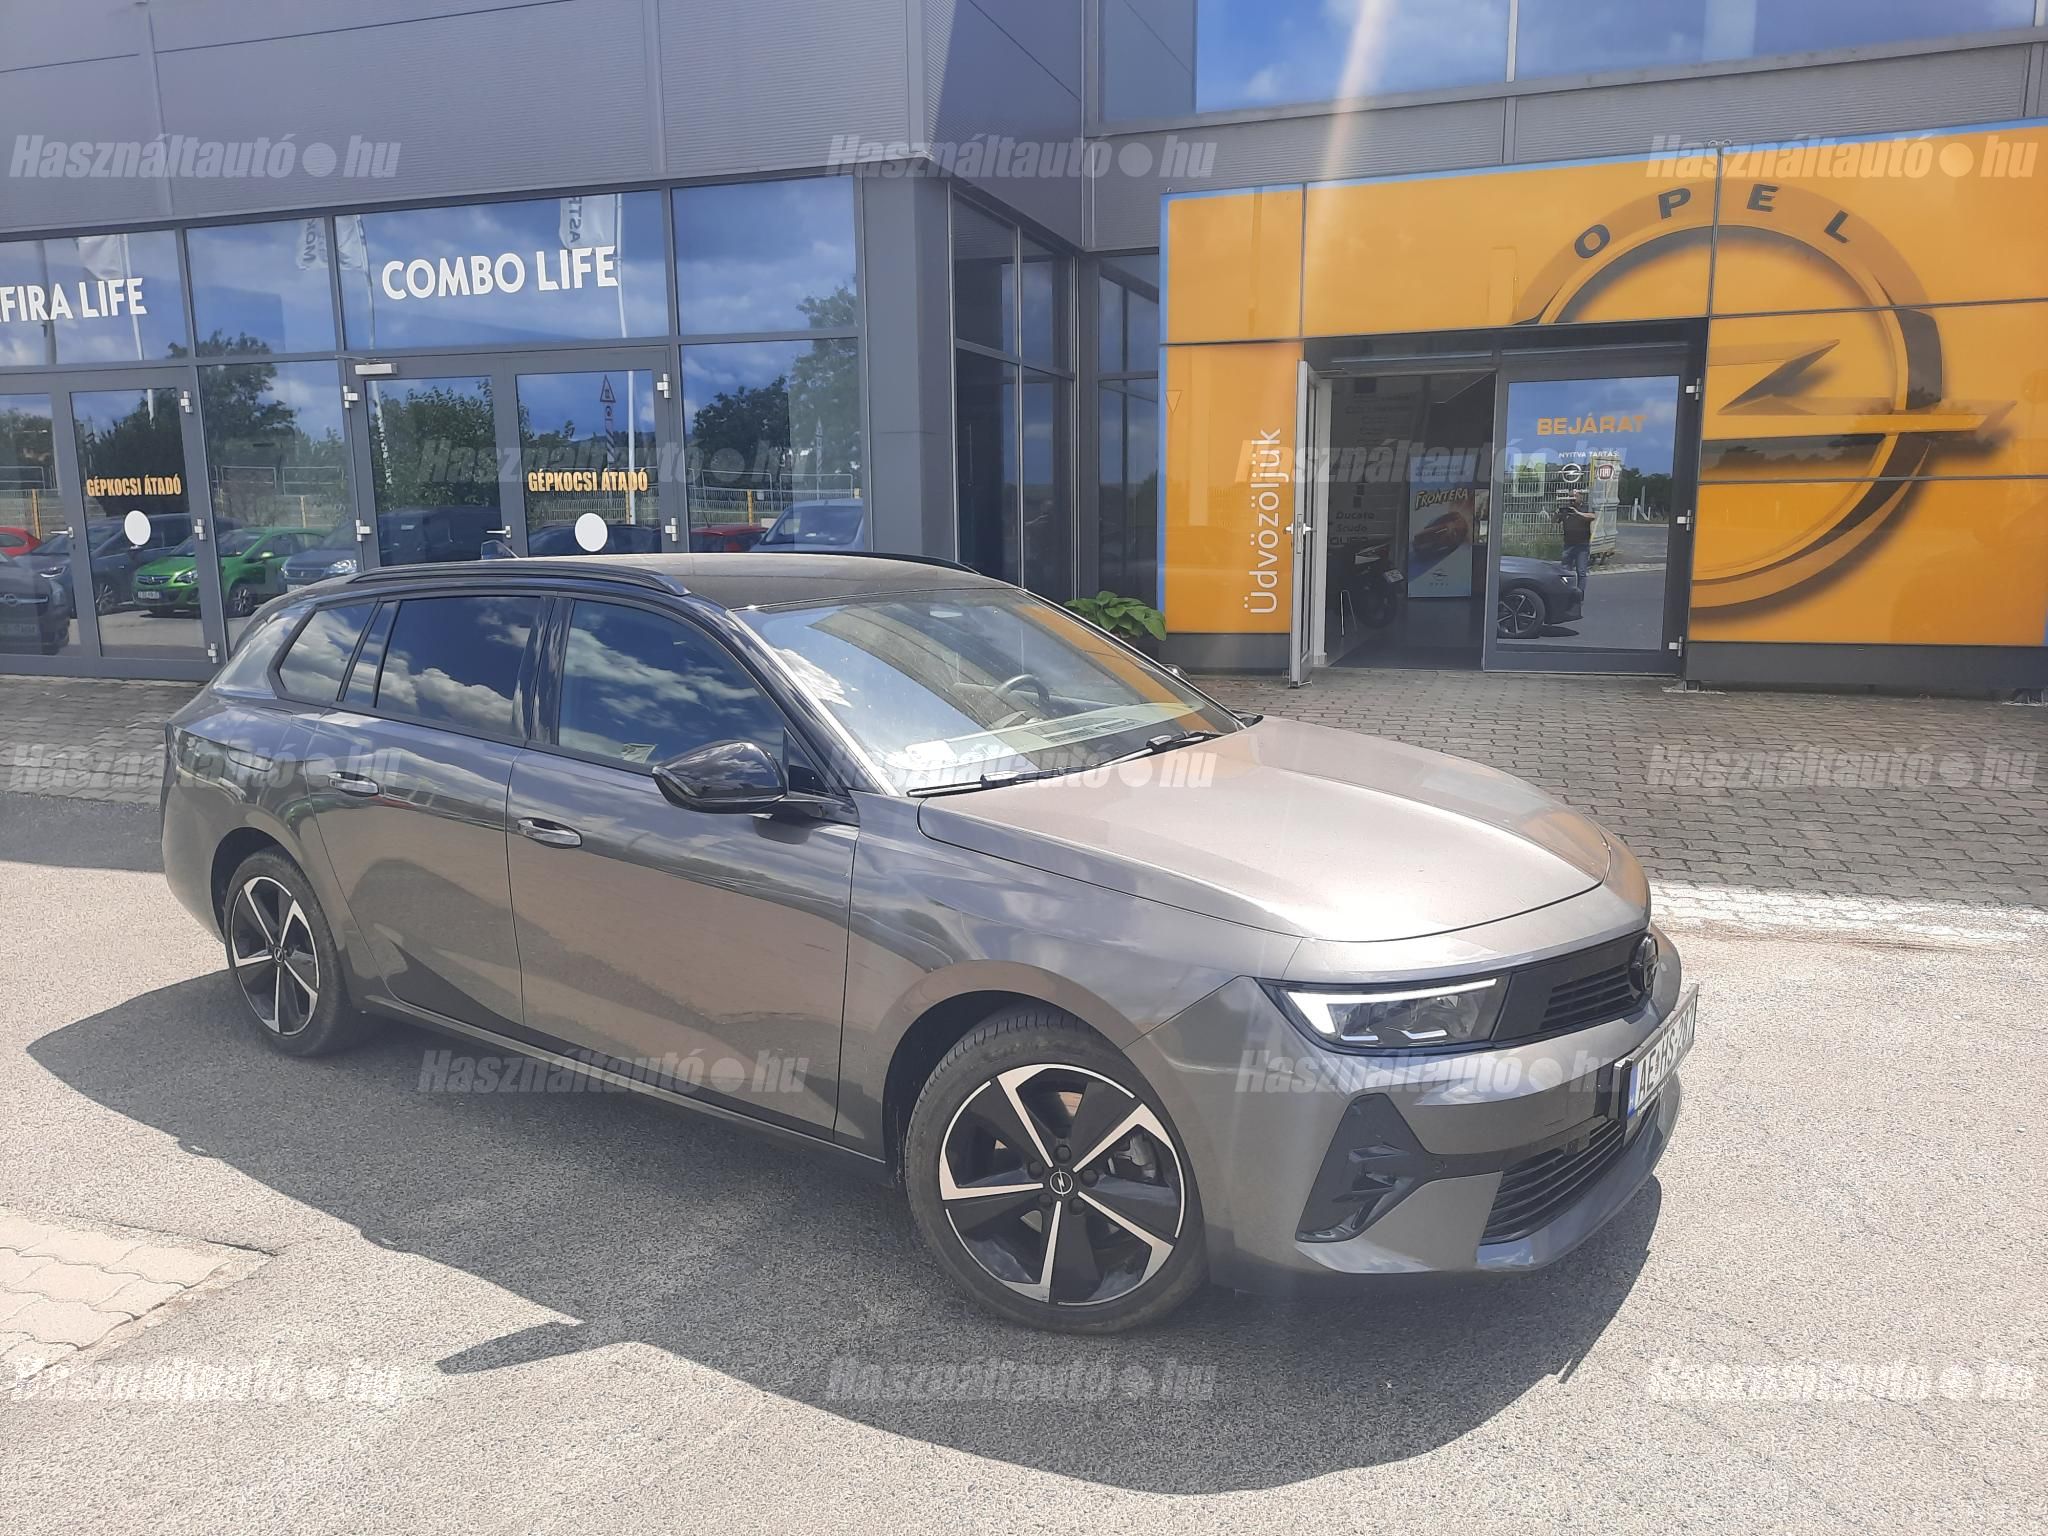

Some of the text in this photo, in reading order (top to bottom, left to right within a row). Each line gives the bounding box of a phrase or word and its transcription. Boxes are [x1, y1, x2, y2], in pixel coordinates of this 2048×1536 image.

[1574, 183, 1850, 259] OPEL
[382, 246, 619, 300] COMBO LIFE
[0, 278, 147, 322] FIRA LIFE
[1536, 413, 1648, 436] BEJÁRAT
[86, 473, 182, 497] GÉPKOCSI ÁTADÓ
[527, 467, 648, 492] GÉPKOCSI ÁTADÓ
[1415, 487, 1468, 510] FRONTERA
[1244, 428, 1290, 614] Üdvözöljük
